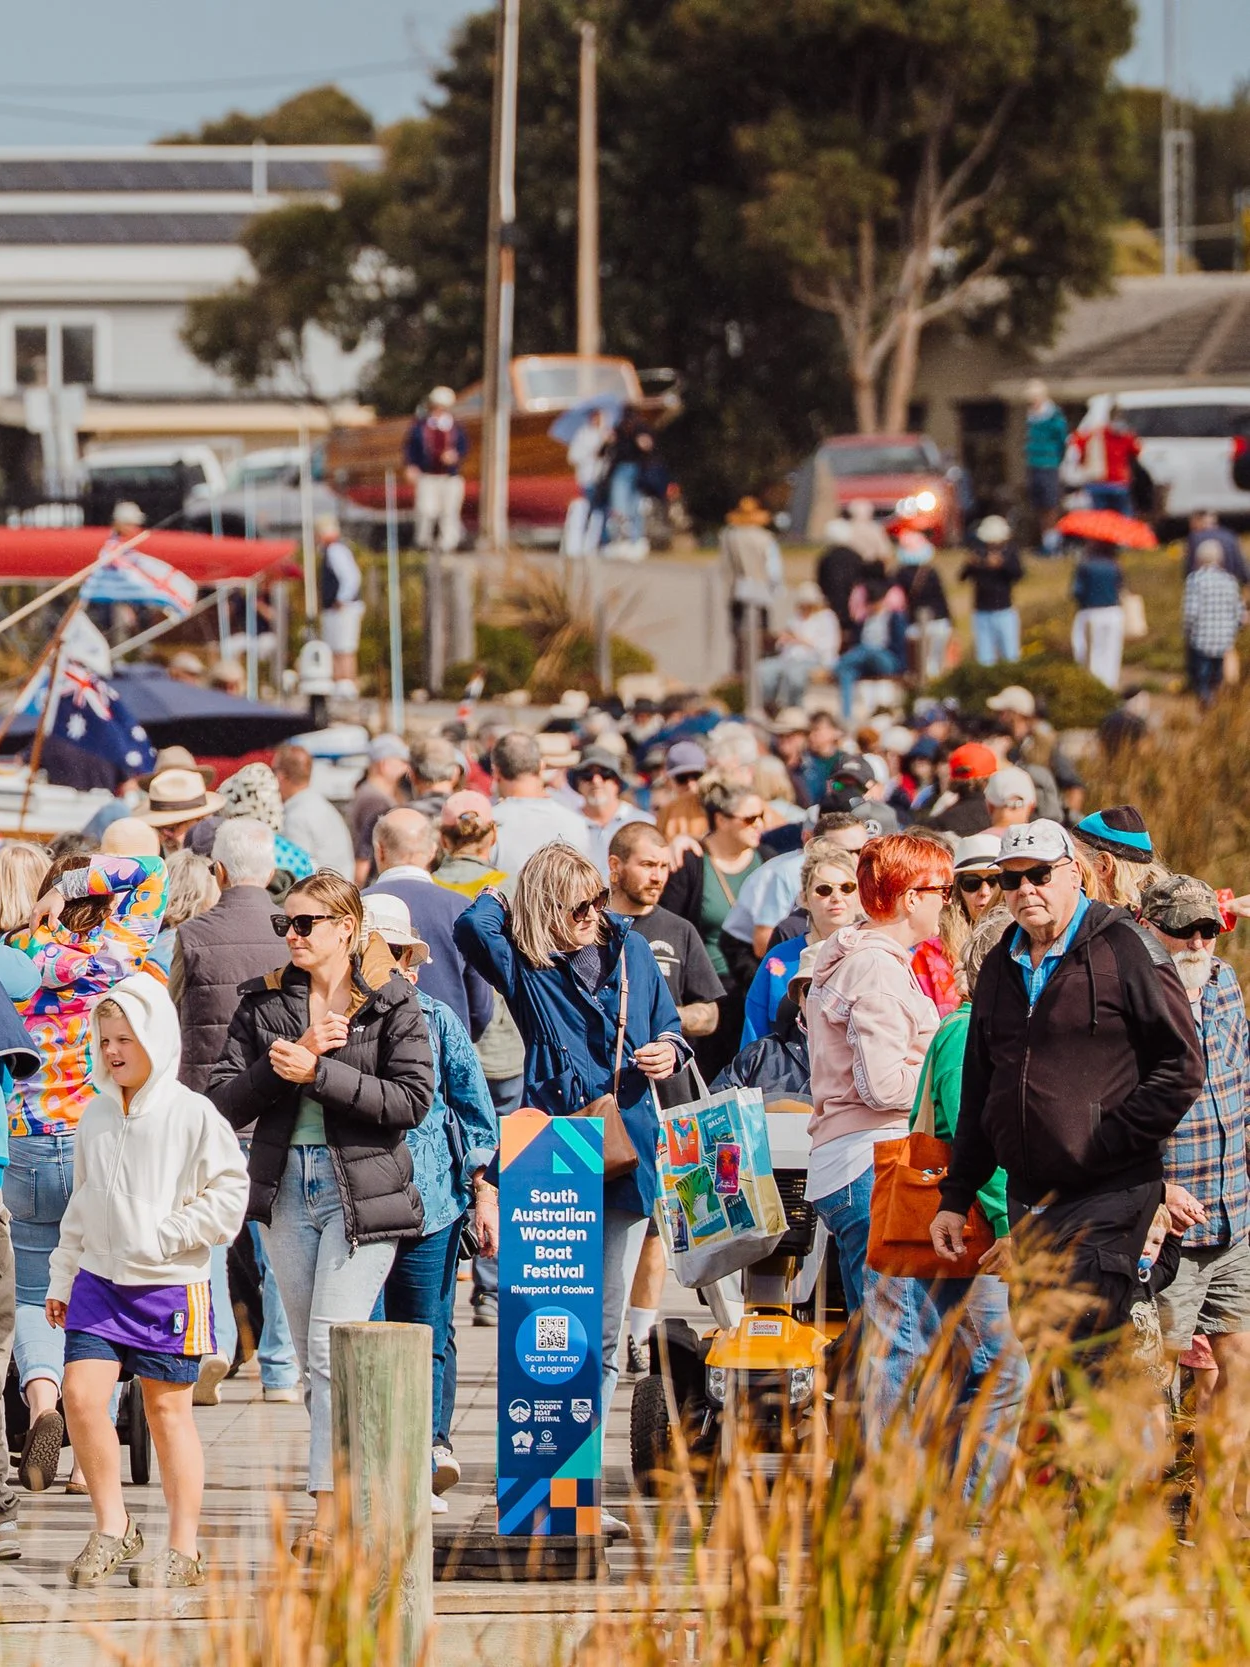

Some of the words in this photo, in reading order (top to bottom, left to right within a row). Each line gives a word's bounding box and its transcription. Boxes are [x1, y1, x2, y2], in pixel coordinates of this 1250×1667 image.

[707, 1114, 727, 1130] BALTIC
[530, 1188, 578, 1204] South
[511, 1207, 596, 1222] Australian
[519, 1226, 587, 1241] Wooden
[535, 1245, 572, 1260] Boat
[523, 1263, 584, 1279] Festival
[510, 1285, 550, 1296] Riverport
[551, 1285, 560, 1294] of
[561, 1285, 594, 1294] Goolwa
[524, 1354, 546, 1363] Scan
[547, 1354, 558, 1362] for
[560, 1355, 580, 1364] map
[529, 1365, 536, 1373] &
[537, 1366, 574, 1375] program
